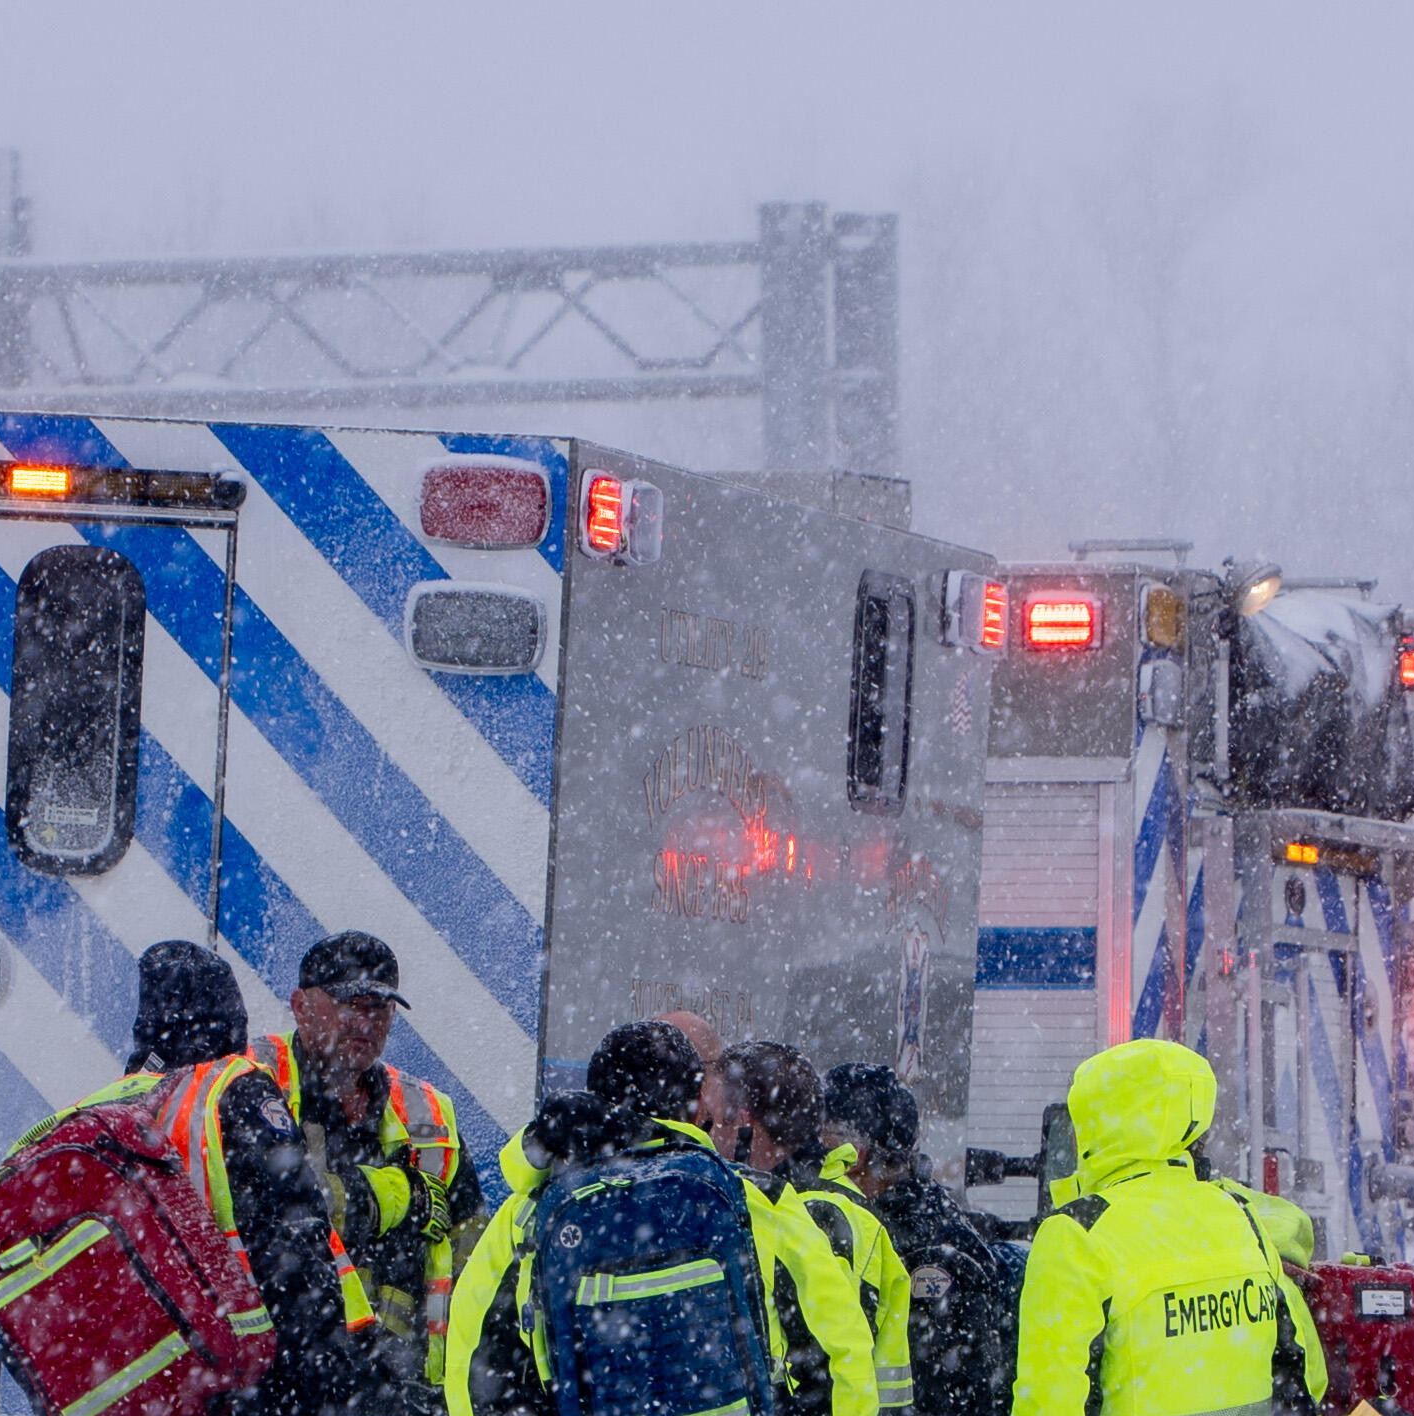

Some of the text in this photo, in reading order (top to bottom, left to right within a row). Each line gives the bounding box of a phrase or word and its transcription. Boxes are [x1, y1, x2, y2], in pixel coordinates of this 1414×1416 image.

[660, 607, 737, 673] UTILITY
[643, 724, 769, 836] VOLUNTEER
[651, 848, 708, 917] SINCE
[1163, 1278, 1277, 1338] EMERGYCAR
